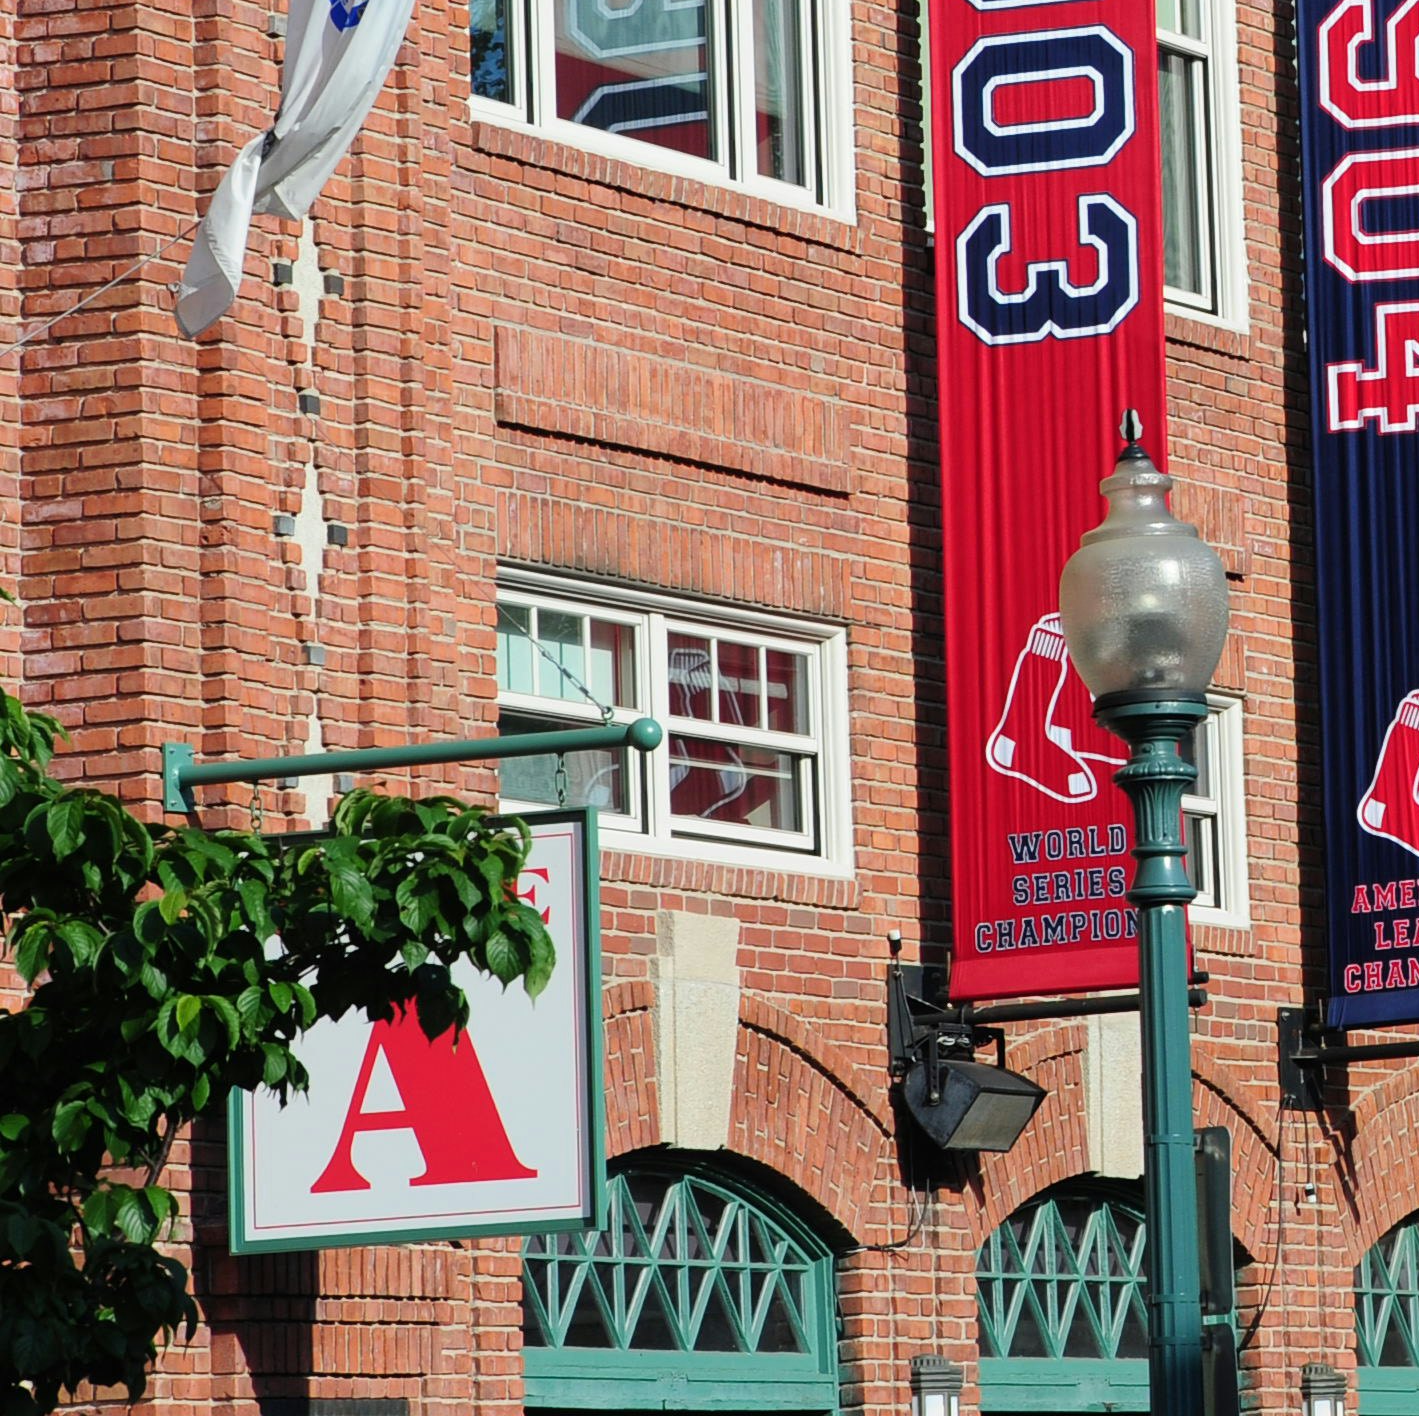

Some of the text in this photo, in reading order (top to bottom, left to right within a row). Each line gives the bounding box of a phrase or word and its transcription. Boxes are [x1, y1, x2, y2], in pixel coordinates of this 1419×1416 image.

[1008, 824, 1127, 864] WORLD
[1013, 867, 1126, 906] SERIES
[975, 908, 1140, 953] CHAMPION
[310, 994, 538, 1194] A
